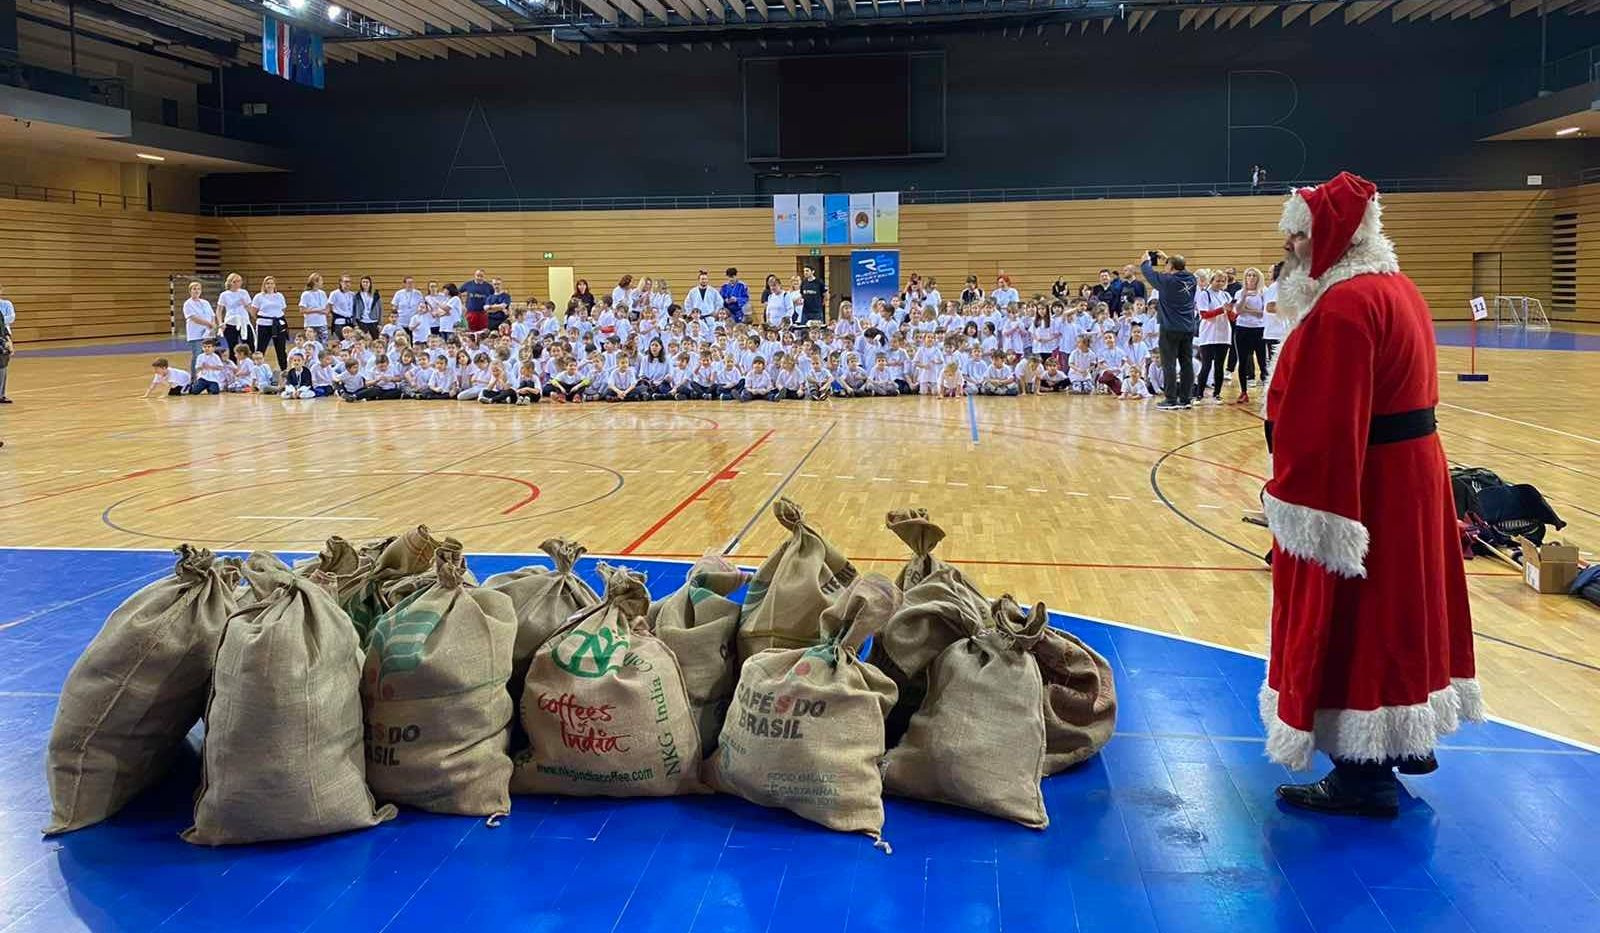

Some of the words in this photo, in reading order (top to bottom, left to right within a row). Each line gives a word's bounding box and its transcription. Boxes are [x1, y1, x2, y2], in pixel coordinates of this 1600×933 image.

[1473, 302, 1485, 313] 11
[537, 691, 617, 729] Coffees
[651, 676, 669, 724] India
[792, 698, 827, 718] DO
[388, 724, 421, 745] DO
[560, 720, 631, 757] India
[740, 708, 804, 740] BRASIL
[366, 745, 400, 767] ASIL
[657, 732, 681, 778] NKG
